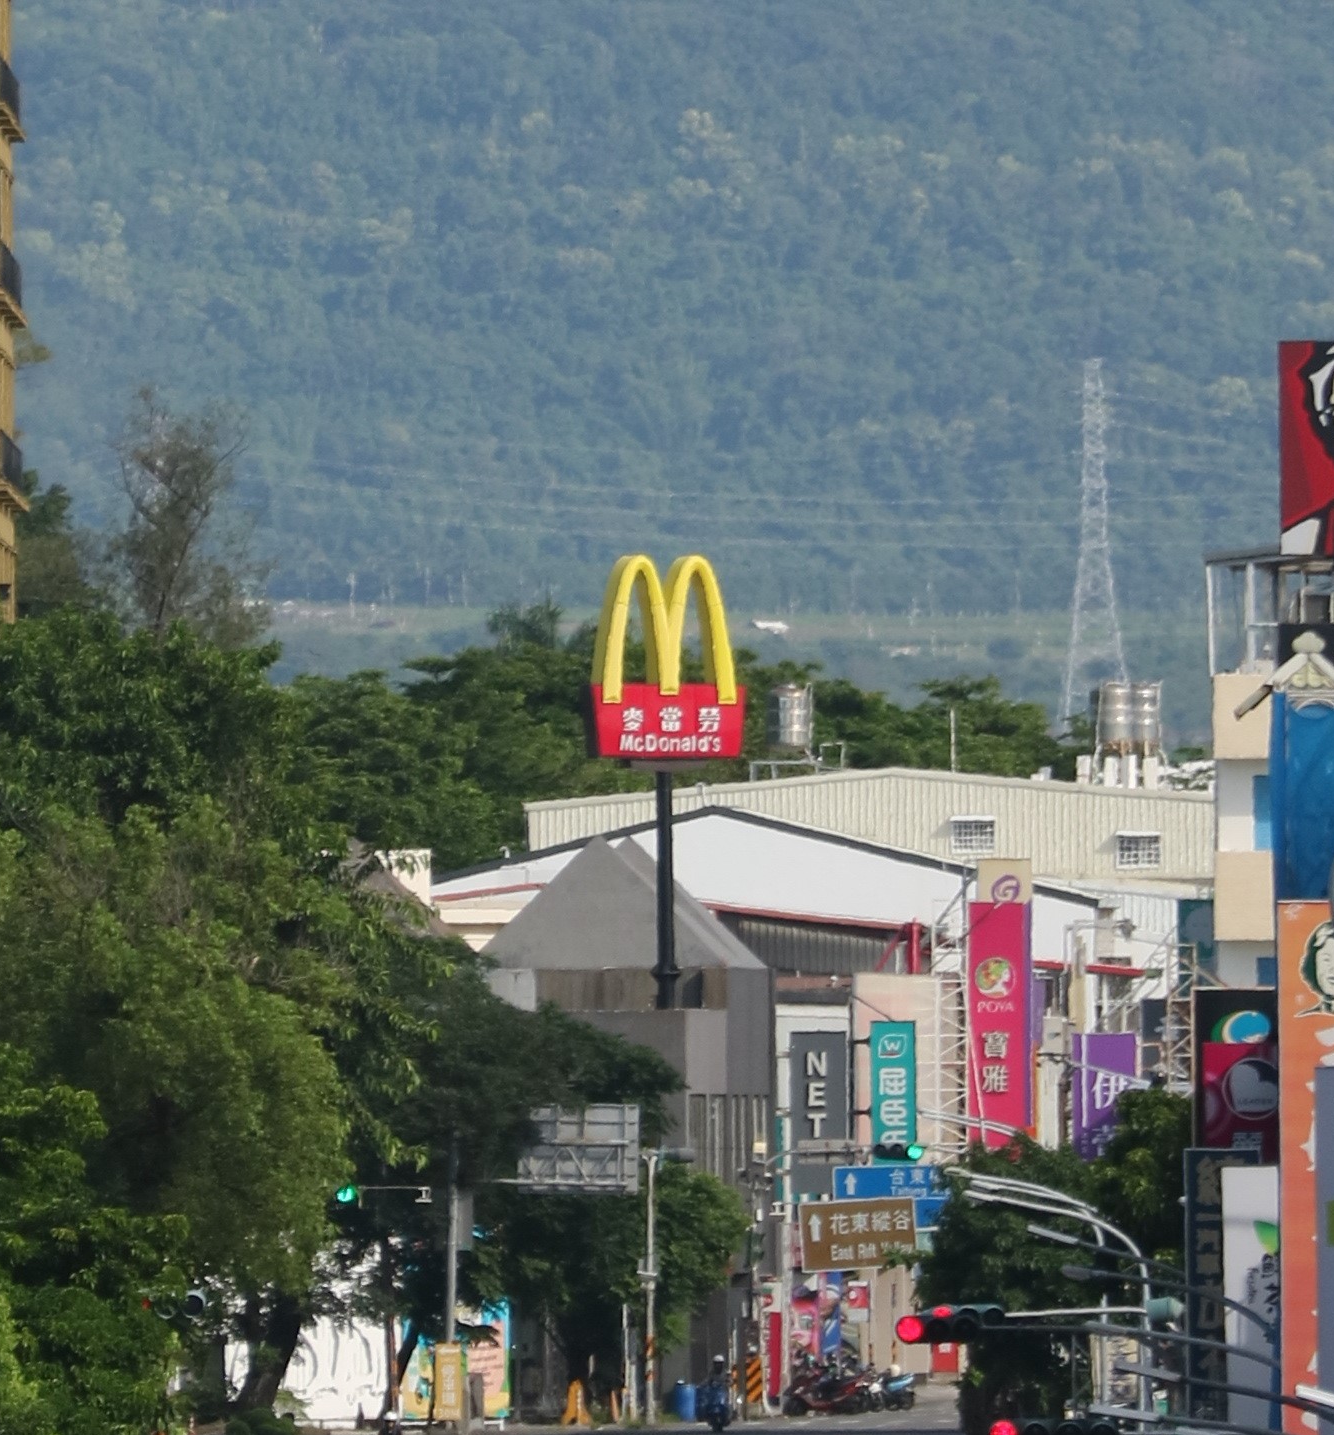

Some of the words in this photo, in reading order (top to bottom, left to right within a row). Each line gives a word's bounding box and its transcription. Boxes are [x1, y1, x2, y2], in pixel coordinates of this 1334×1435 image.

[621, 706, 722, 733] 麥當勞
[619, 734, 722, 753] McDonald's
[977, 1001, 1014, 1013] POYA
[981, 1031, 1010, 1093] 寶雅
[806, 1050, 828, 1139] NET
[829, 1209, 912, 1236] 花東縱谷
[830, 1244, 854, 1262] East
